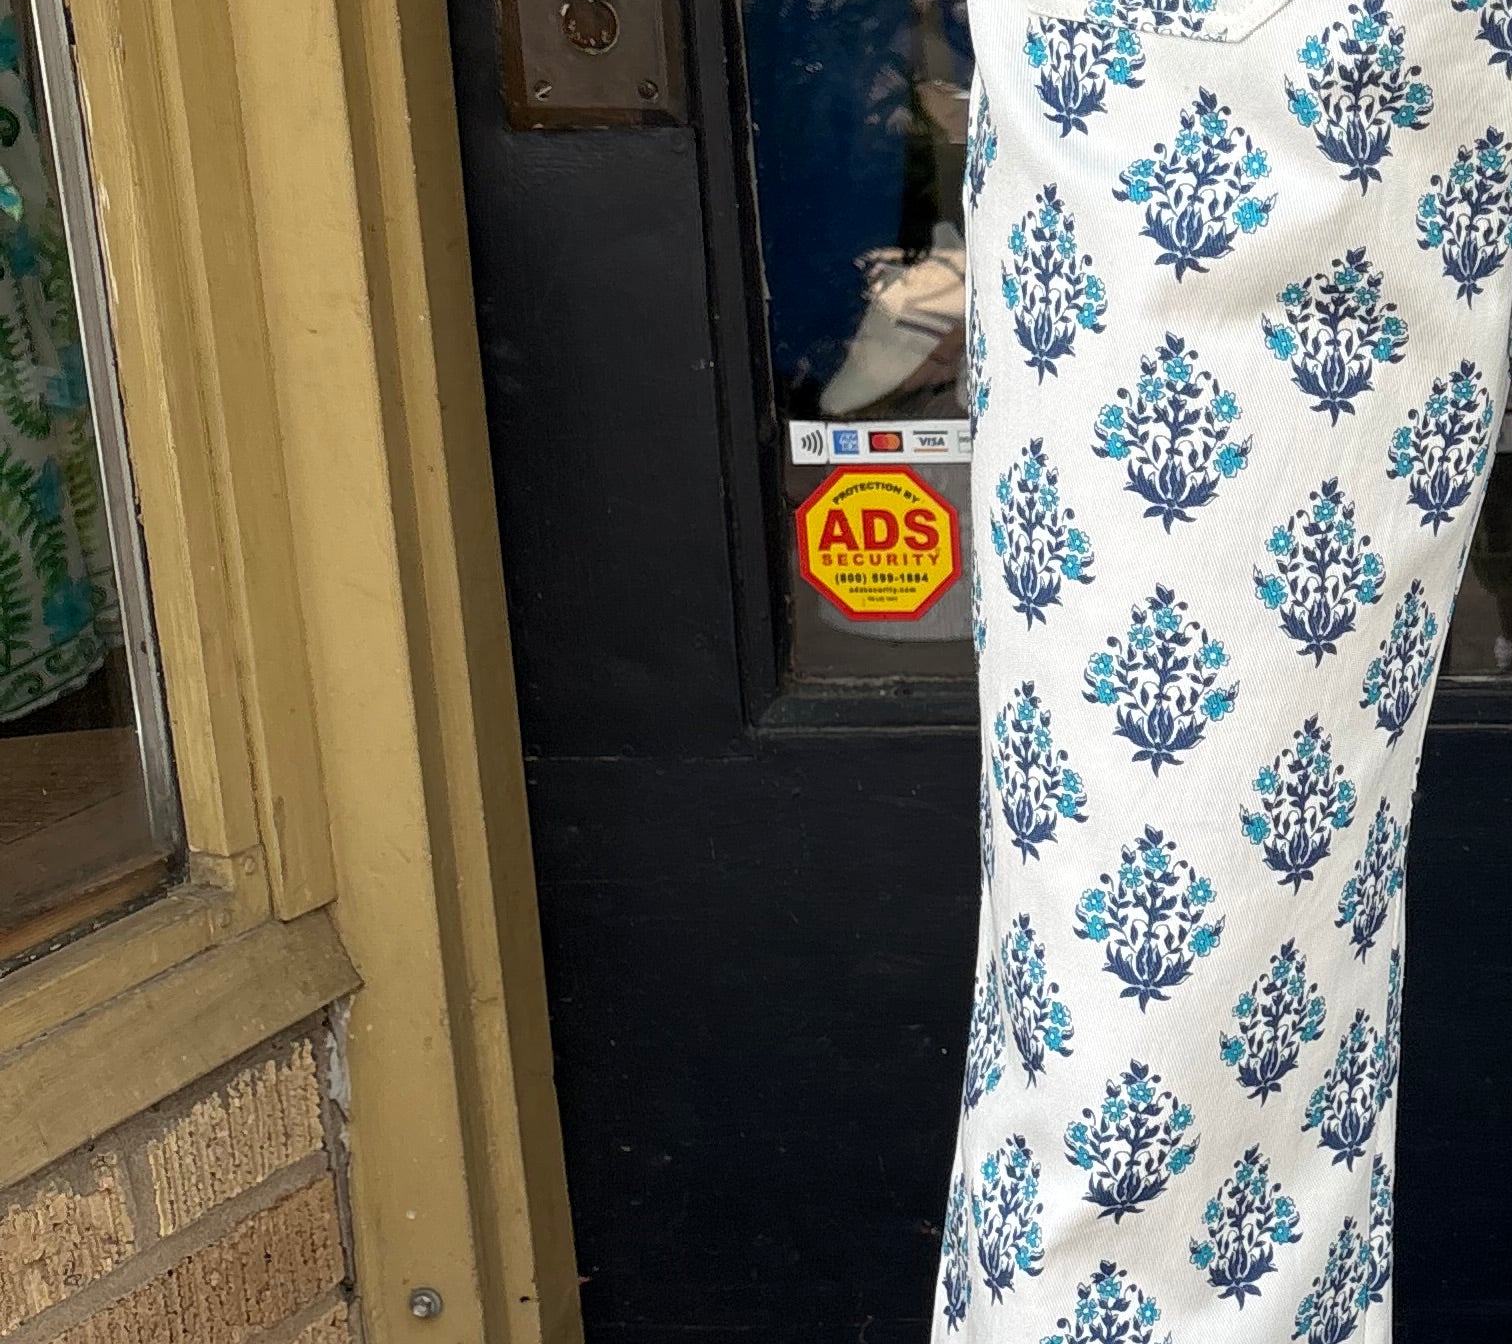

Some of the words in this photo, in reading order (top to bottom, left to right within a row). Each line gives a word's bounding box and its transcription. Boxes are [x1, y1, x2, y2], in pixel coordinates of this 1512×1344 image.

[918, 437, 946, 447] VISA
[832, 481, 902, 505] PROTECTION
[903, 490, 920, 503] BY
[818, 508, 940, 551] ADS
[822, 553, 939, 567] SECURITY
